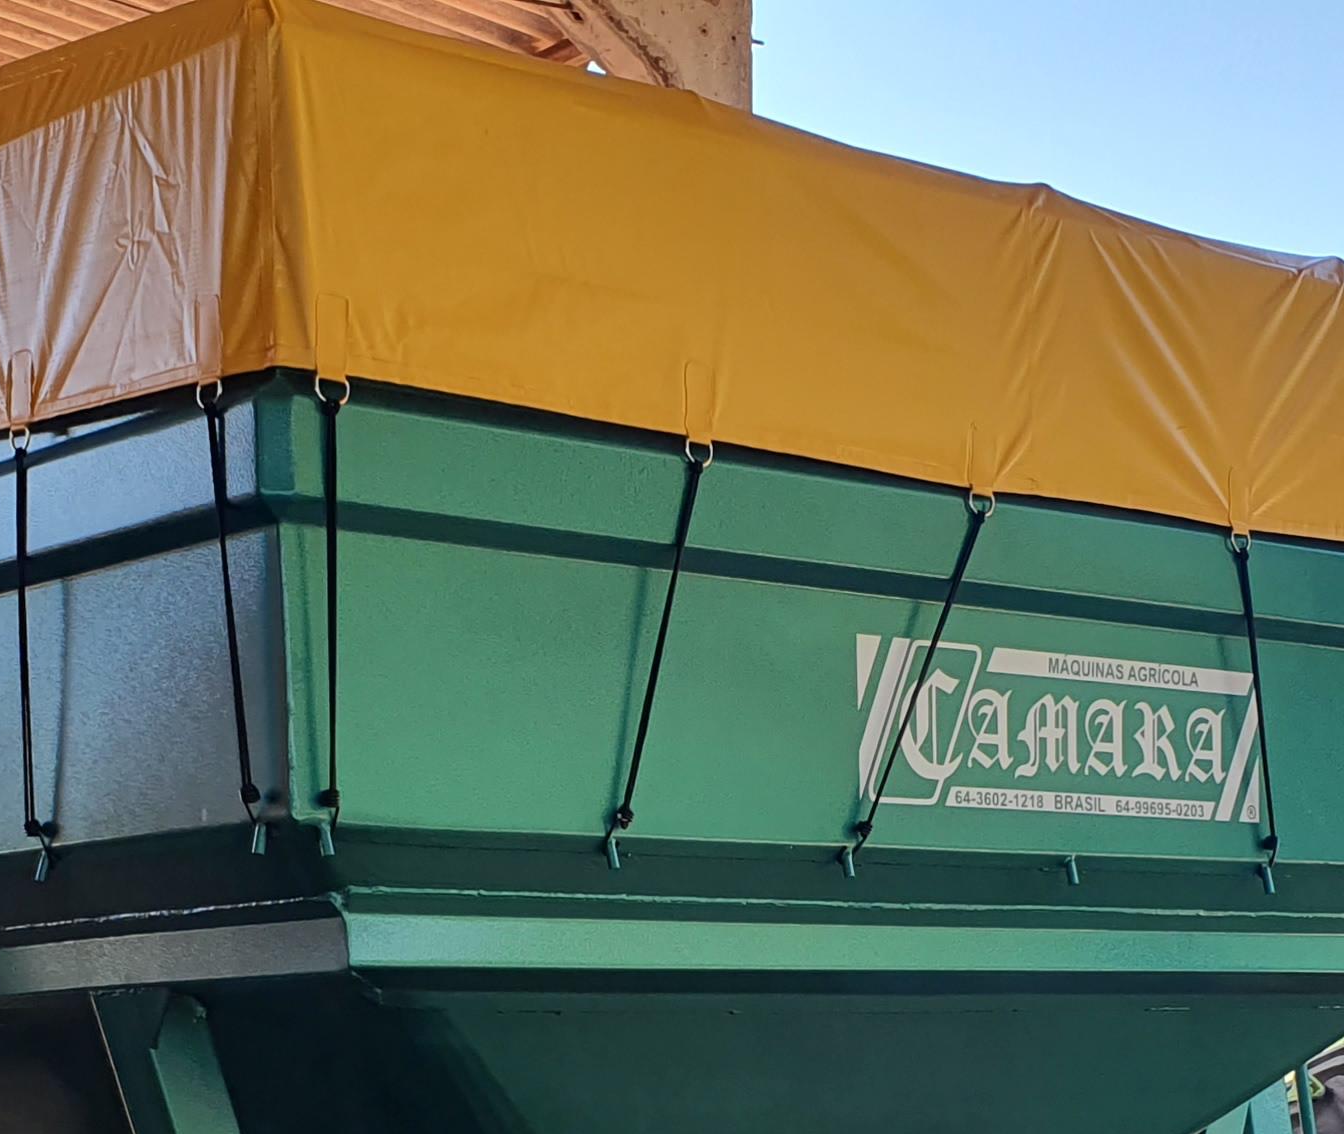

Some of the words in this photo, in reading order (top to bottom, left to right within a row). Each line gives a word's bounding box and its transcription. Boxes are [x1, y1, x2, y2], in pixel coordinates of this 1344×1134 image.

[1128, 664, 1199, 687] AGRÍCOLA
[899, 668, 1226, 784] CAMARA
[955, 790, 1044, 809] 64-3602-1218
[1054, 795, 1105, 813] BRASIL
[1115, 800, 1205, 818] 64-99695-0203
